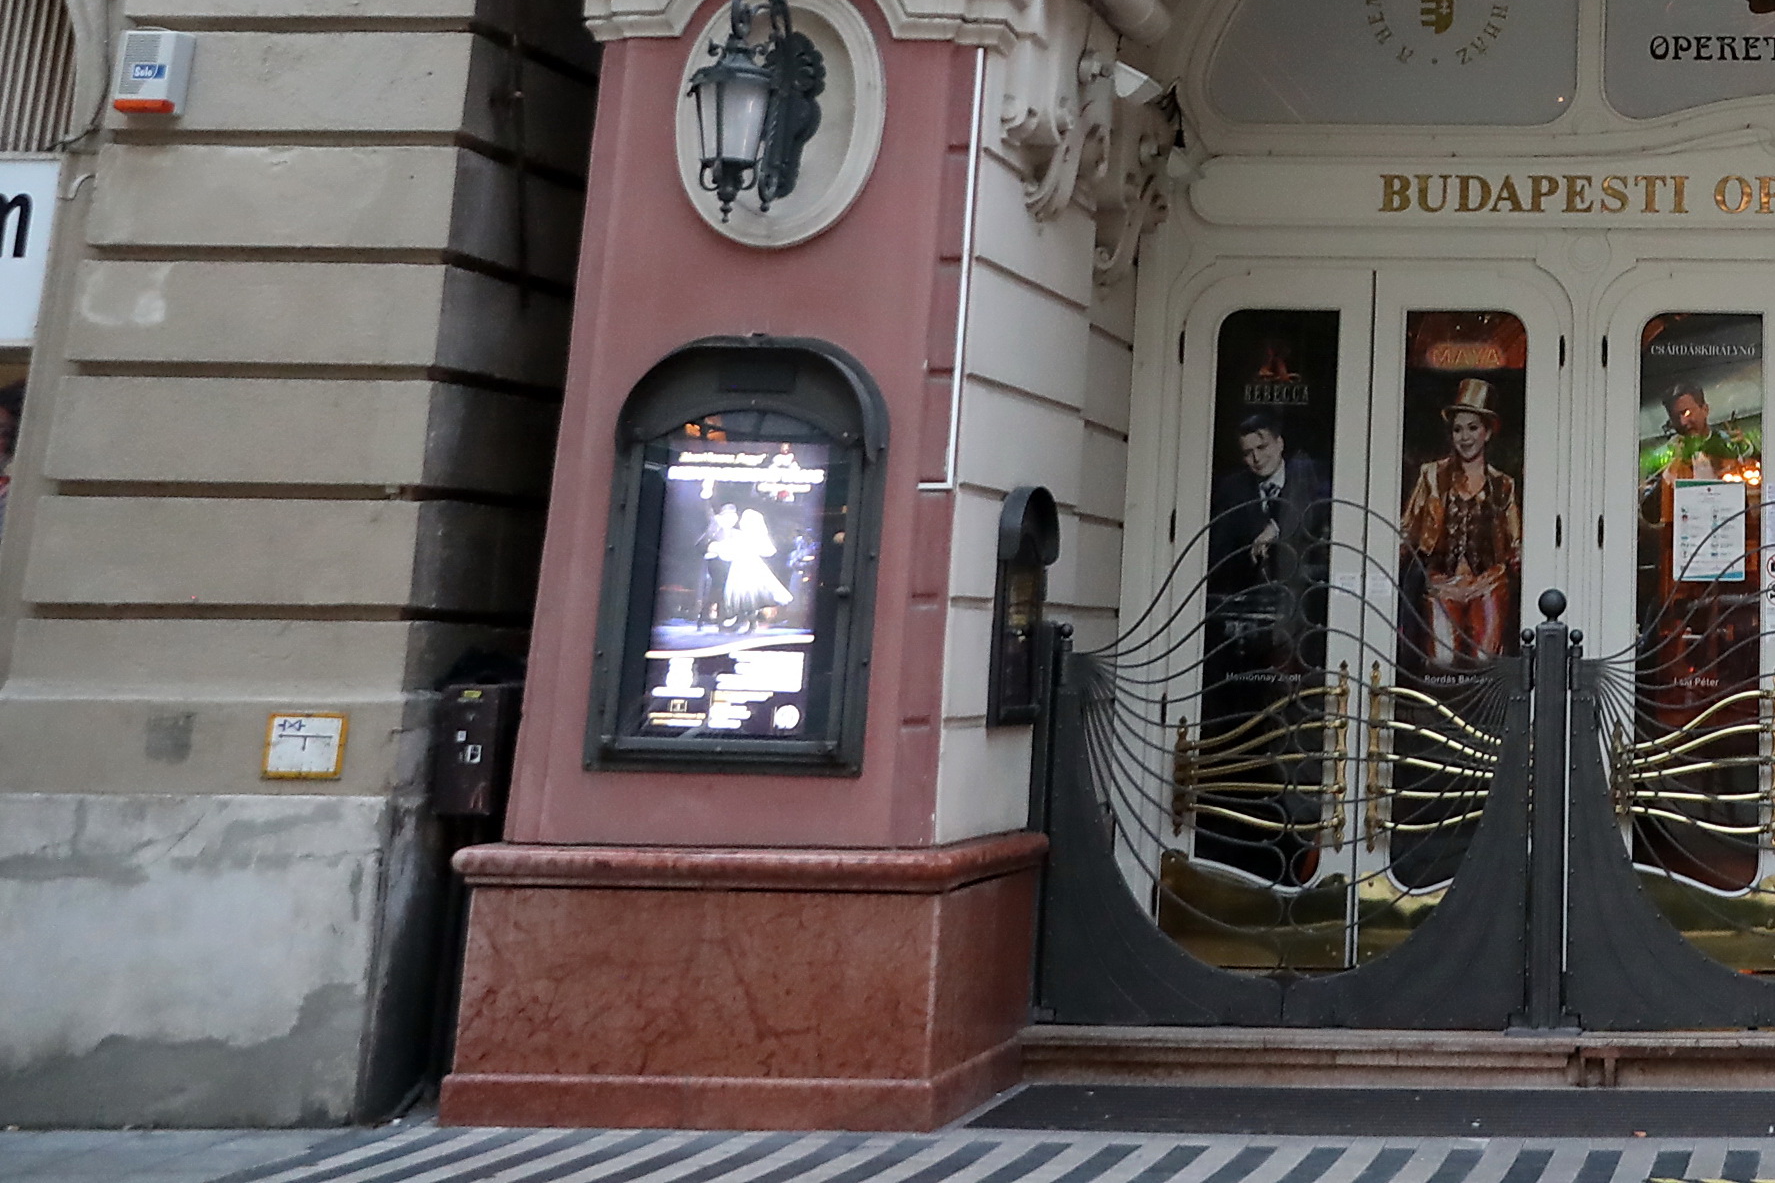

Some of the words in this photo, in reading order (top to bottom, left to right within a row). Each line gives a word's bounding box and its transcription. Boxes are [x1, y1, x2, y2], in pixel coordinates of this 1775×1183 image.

[1378, 172, 1690, 215] BUDAPESTI
[1432, 348, 1500, 366] MAYA
[1244, 384, 1309, 402] REBECCA
[1694, 676, 1719, 686] Péter
